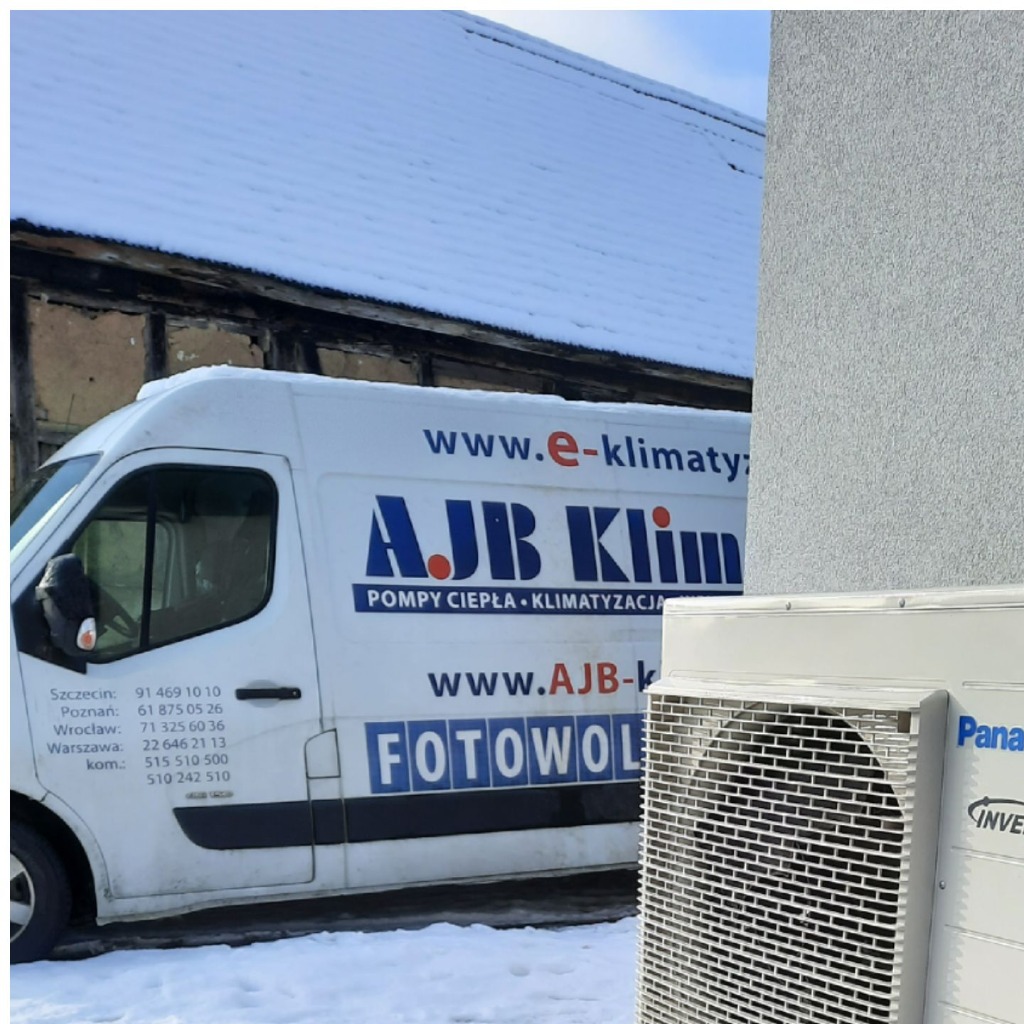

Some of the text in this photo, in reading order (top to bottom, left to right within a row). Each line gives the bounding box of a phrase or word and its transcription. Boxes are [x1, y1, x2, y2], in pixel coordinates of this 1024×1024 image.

[366, 495, 743, 584] AJB Klim
[368, 591, 665, 611] POMPY CIEPŁA KLIMATYZACJA
[428, 661, 656, 697] www.AJB-k
[50, 686, 221, 700] Szczecin: 91 469 10 10
[61, 703, 223, 718] Poznań: 61 875 05 26
[53, 720, 225, 736] Wrocław: 71 325 60 36
[47, 737, 226, 754] Warszawa: 22 646 21 13
[86, 754, 228, 771] kom.: 515 510 500
[377, 725, 641, 786] FOTOWOL
[147, 771, 230, 785] 510 242 510
